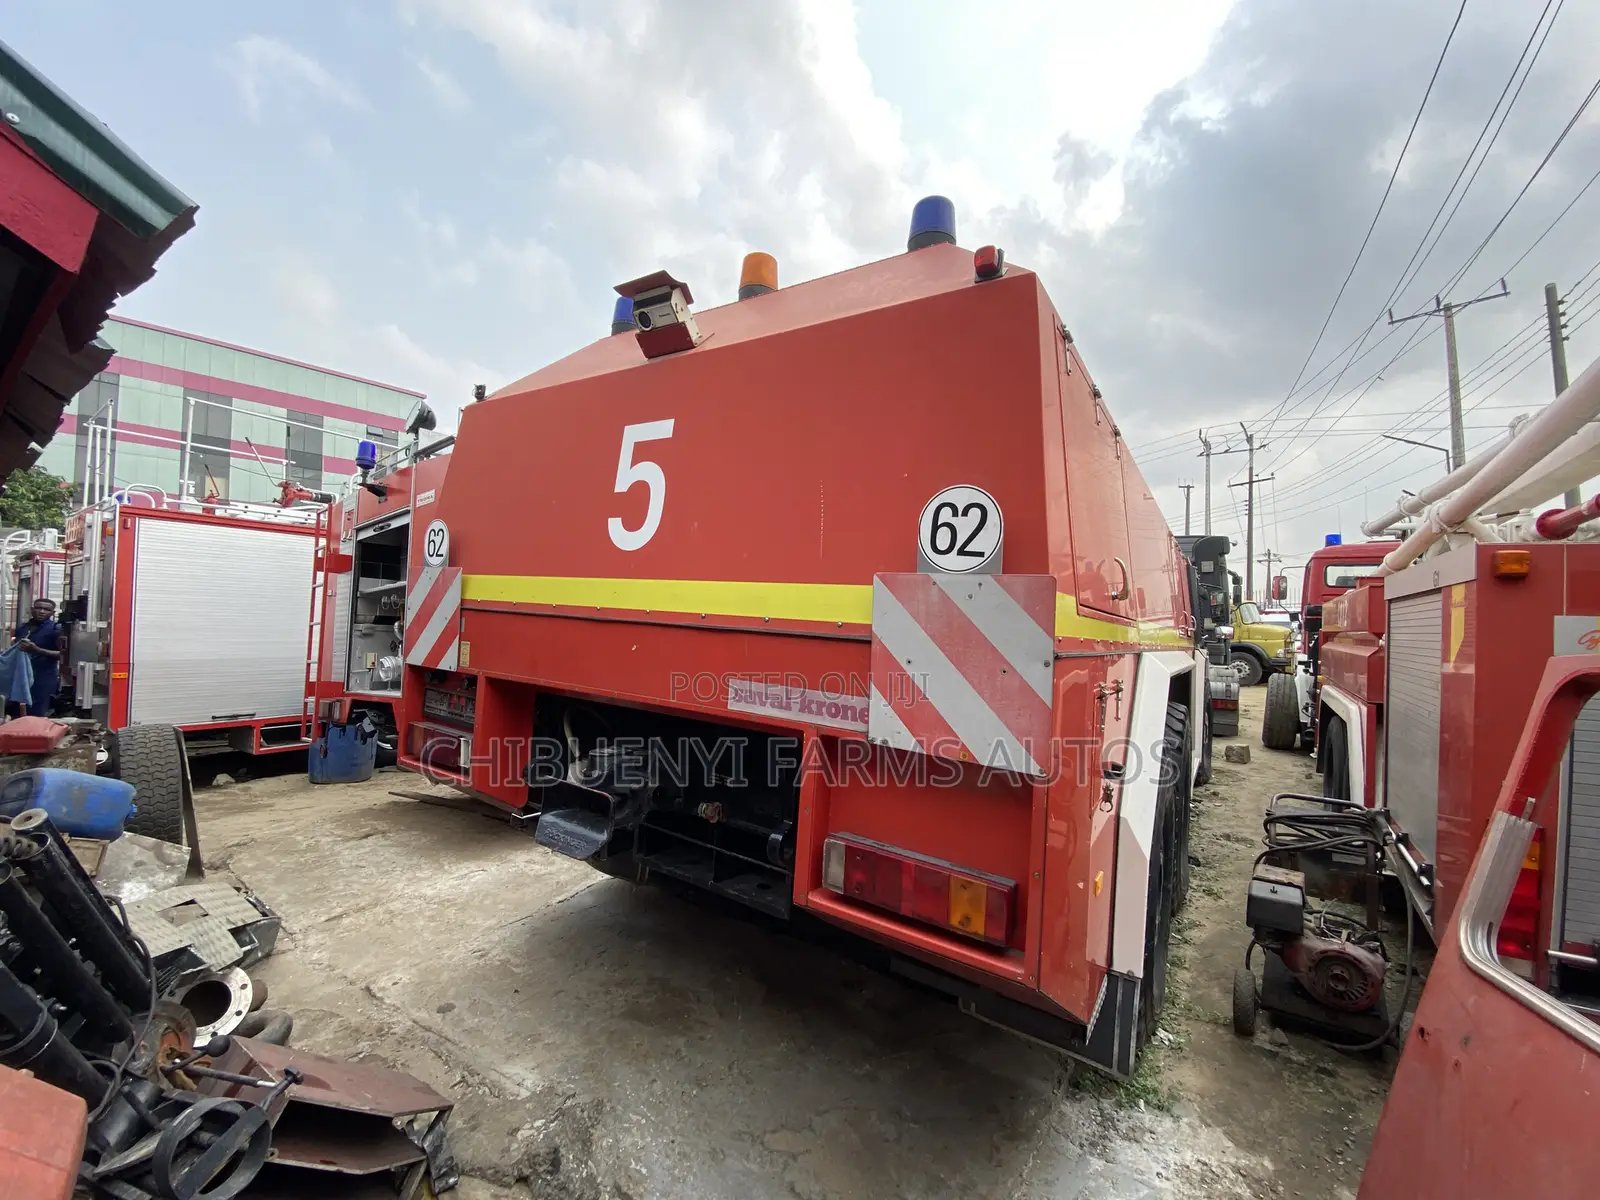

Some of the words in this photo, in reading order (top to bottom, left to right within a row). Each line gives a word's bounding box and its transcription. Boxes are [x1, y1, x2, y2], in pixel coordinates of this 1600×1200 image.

[608, 418, 675, 551] 5
[427, 528, 445, 558] 62
[929, 502, 988, 557] 62
